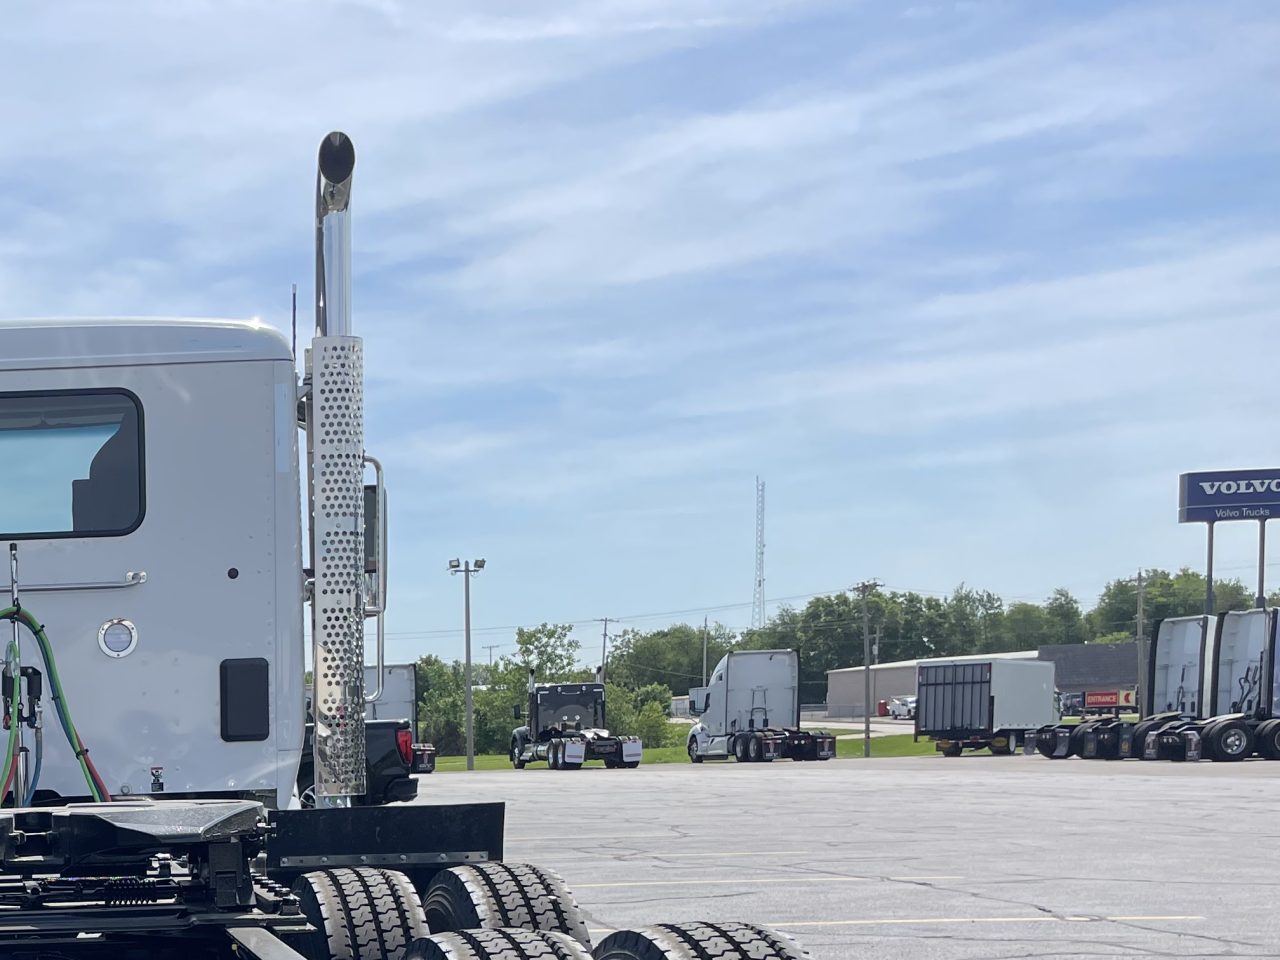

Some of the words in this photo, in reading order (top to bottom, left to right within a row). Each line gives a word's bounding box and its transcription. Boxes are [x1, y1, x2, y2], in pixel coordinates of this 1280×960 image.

[1199, 478, 1280, 495] VOLVO
[1215, 509, 1240, 518] Volvo
[1242, 507, 1270, 517] Trucks
[1087, 695, 1117, 703] ENTRANCE
